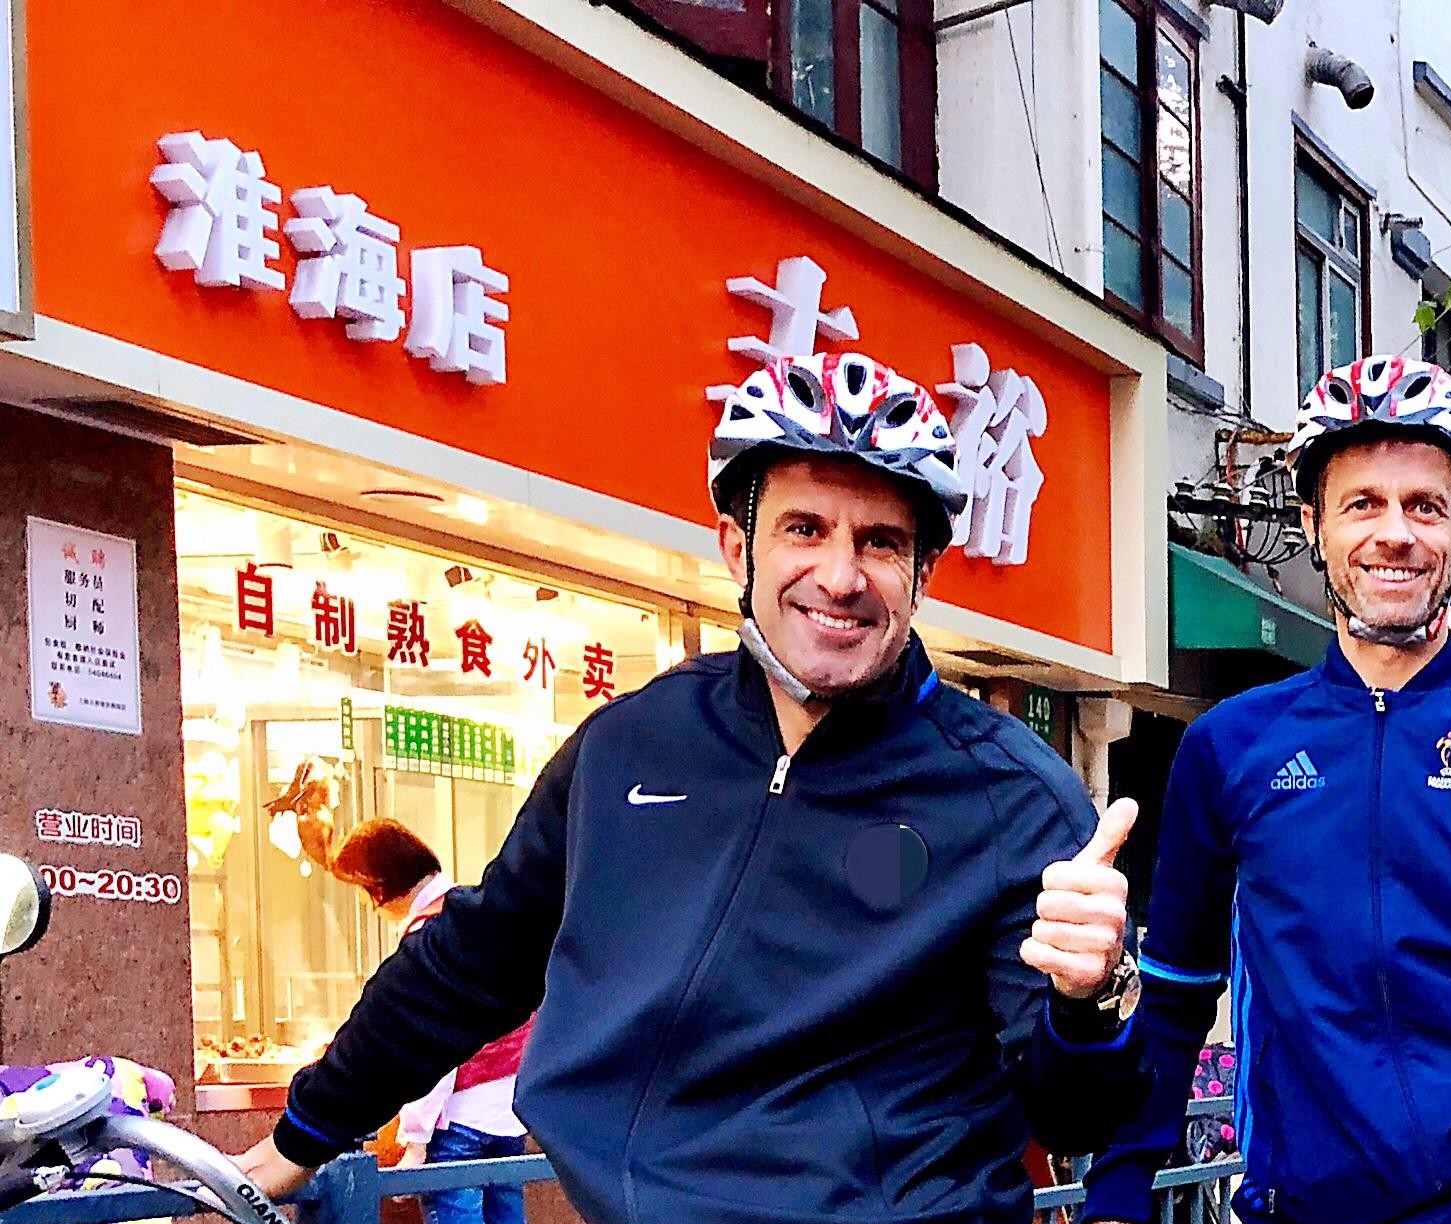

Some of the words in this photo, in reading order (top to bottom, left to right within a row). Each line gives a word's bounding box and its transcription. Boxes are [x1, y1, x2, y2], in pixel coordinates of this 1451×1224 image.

[150, 130, 509, 384] 淮海店
[236, 562, 614, 700] 自制熟食外卖
[38, 811, 140, 846] 营业时间
